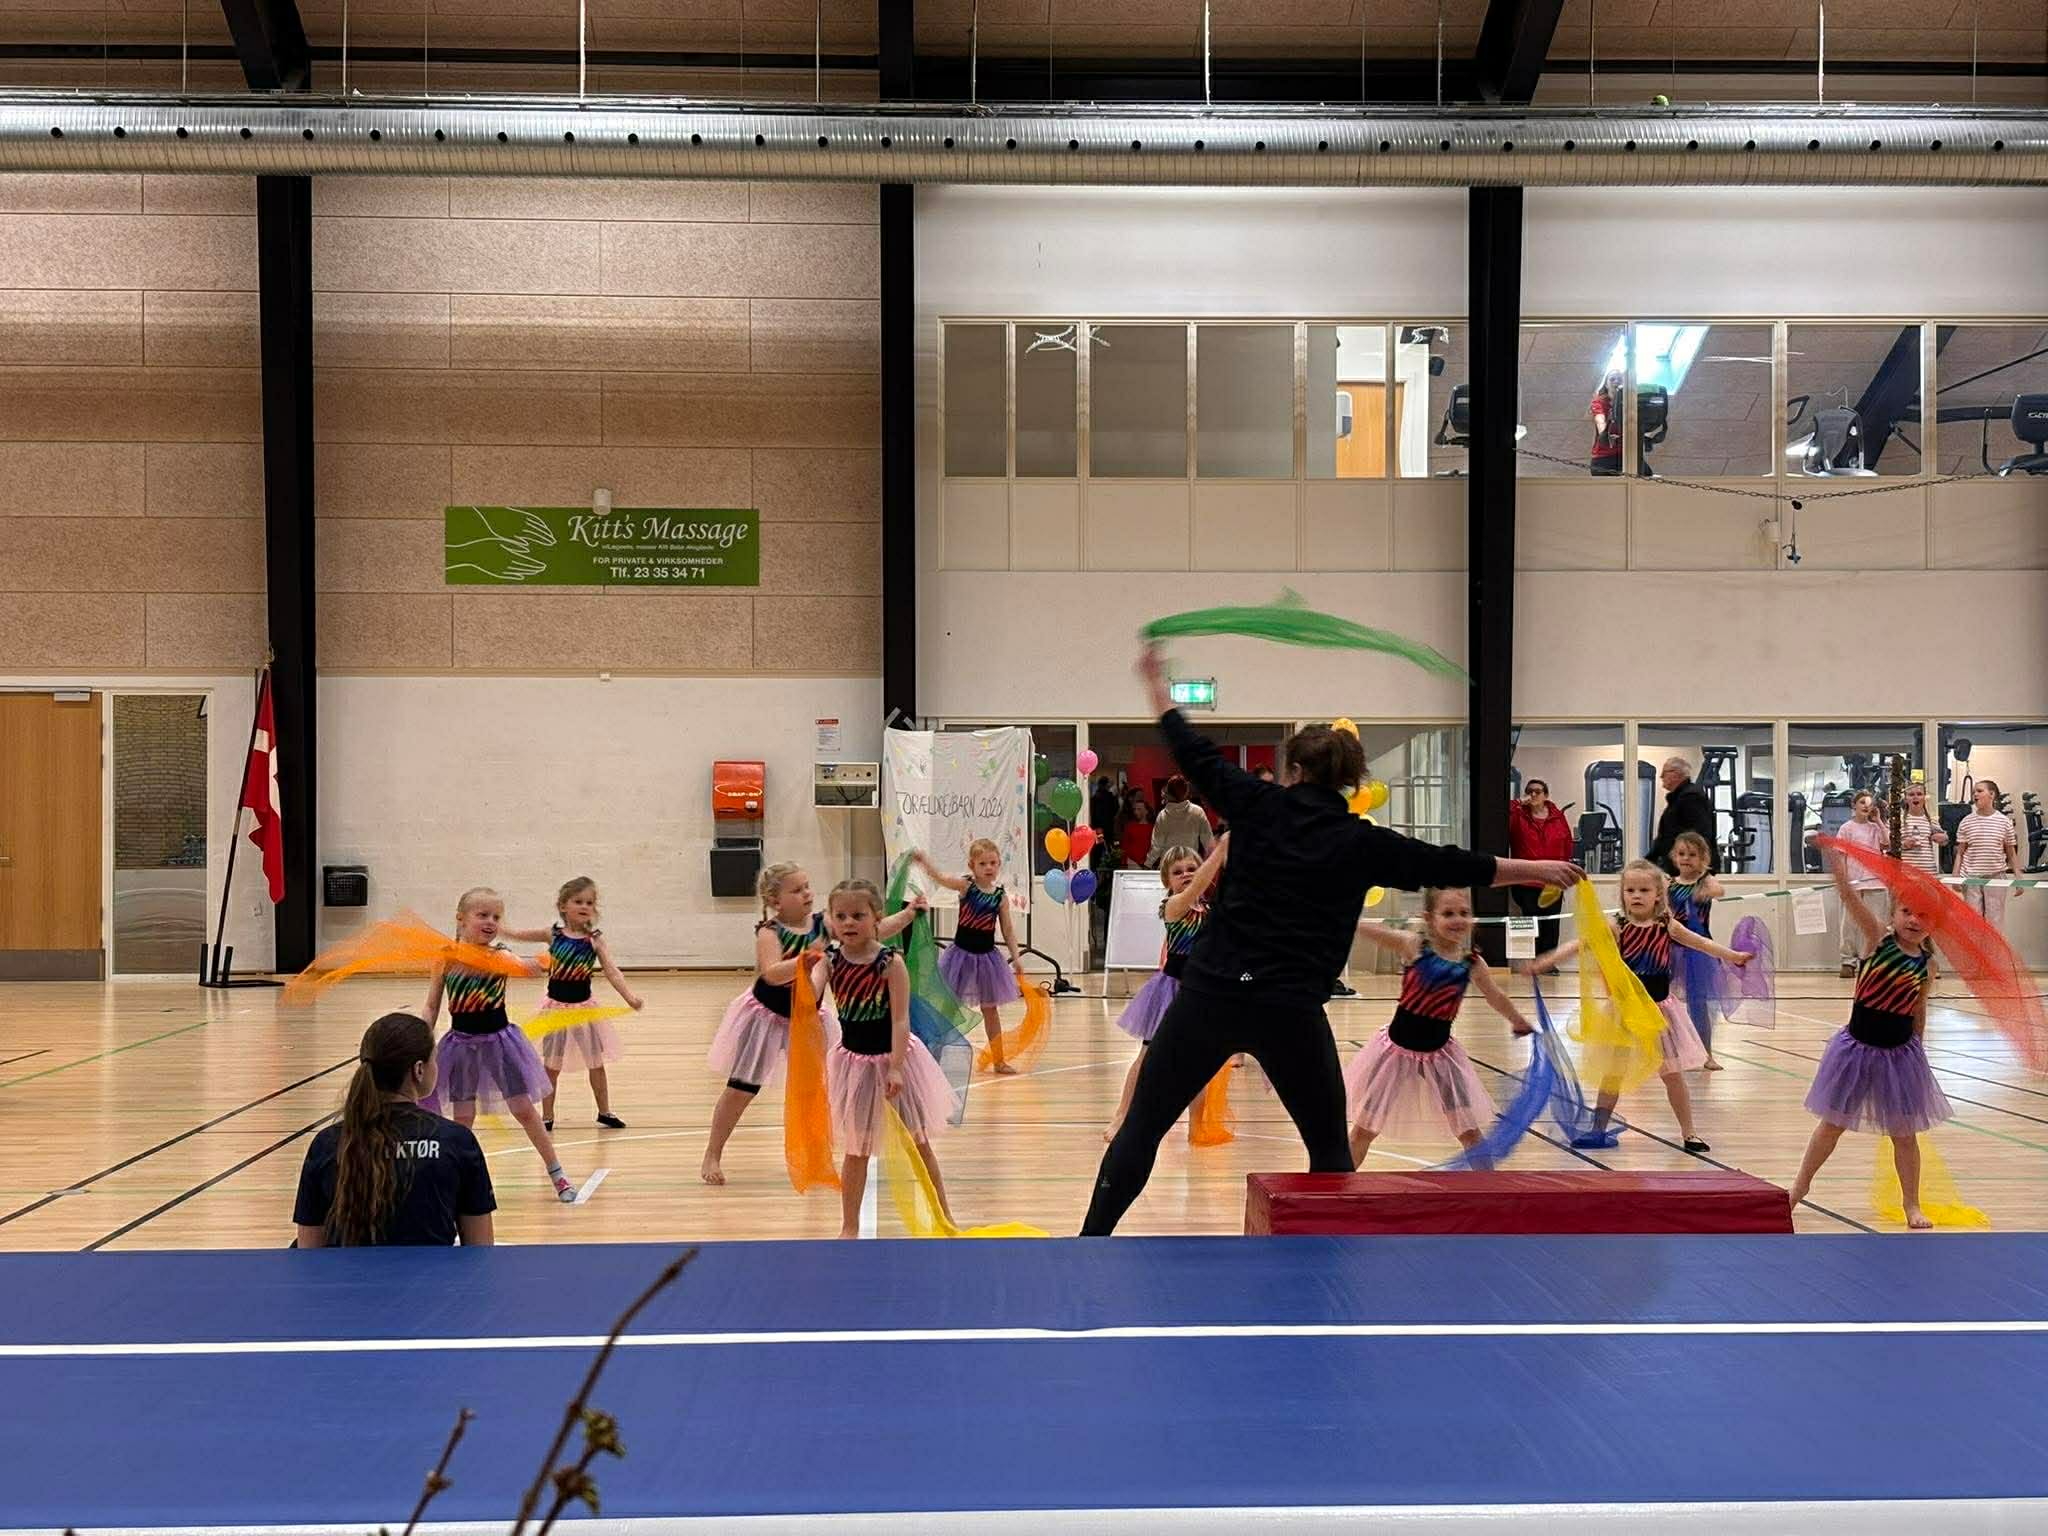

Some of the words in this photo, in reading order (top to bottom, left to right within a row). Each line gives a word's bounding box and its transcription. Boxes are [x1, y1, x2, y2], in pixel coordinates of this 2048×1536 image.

[567, 514, 635, 547] Kitt's
[641, 516, 749, 548] Massage
[592, 556, 611, 565] FOR
[612, 556, 647, 565] PRIVATE
[647, 556, 655, 565] &
[656, 556, 724, 566] VIRKSOMHEDER
[609, 566, 631, 578] Tlf.
[634, 566, 650, 579] 23
[652, 566, 669, 579] 35
[671, 566, 688, 579] 34
[690, 566, 706, 579] 71
